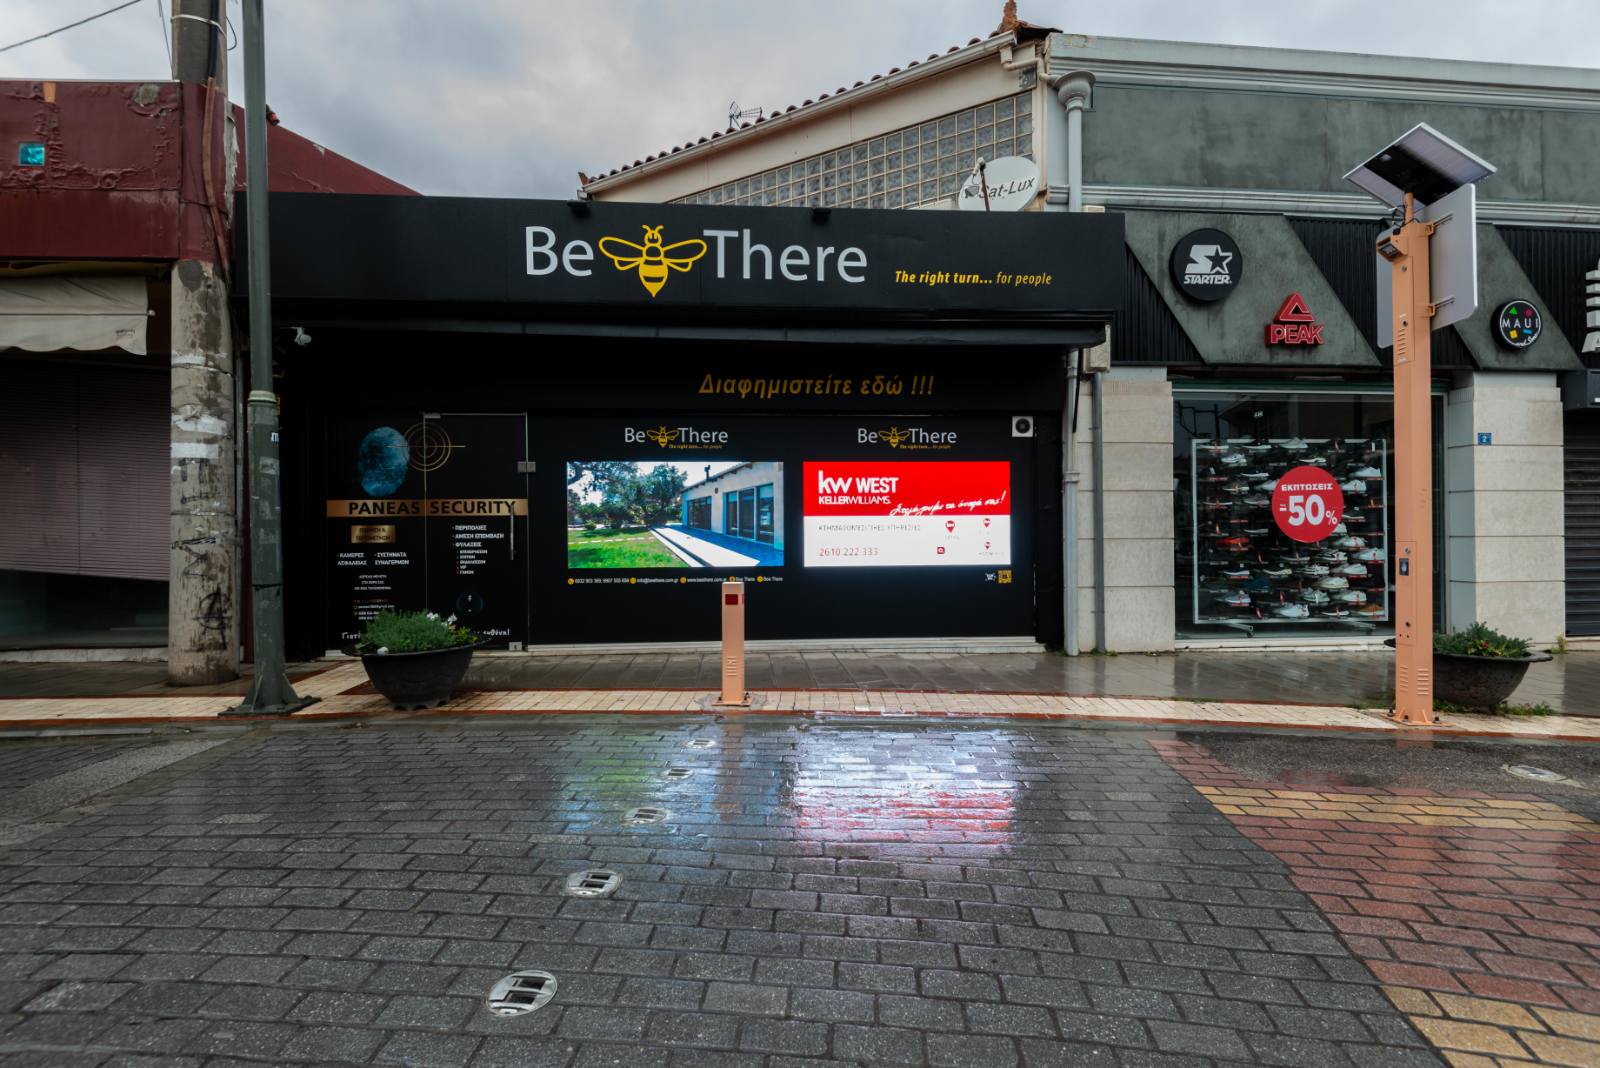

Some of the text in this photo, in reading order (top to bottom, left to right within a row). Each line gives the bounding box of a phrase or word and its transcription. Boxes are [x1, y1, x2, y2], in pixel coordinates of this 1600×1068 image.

[525, 226, 869, 283] Be There
[895, 270, 1053, 287] The right turn... for people
[1183, 274, 1230, 284] STARTER
[1266, 324, 1325, 345] PEAK
[698, 373, 935, 399] Διαφημιστείτε εδώ !!!
[624, 427, 729, 443] Be There
[857, 427, 958, 444] Be There
[818, 470, 899, 494] kw WEST
[1281, 483, 1334, 492] ΕΚΠΤΩΣΕΙΣ
[349, 501, 516, 514] PANEAS SECURITY
